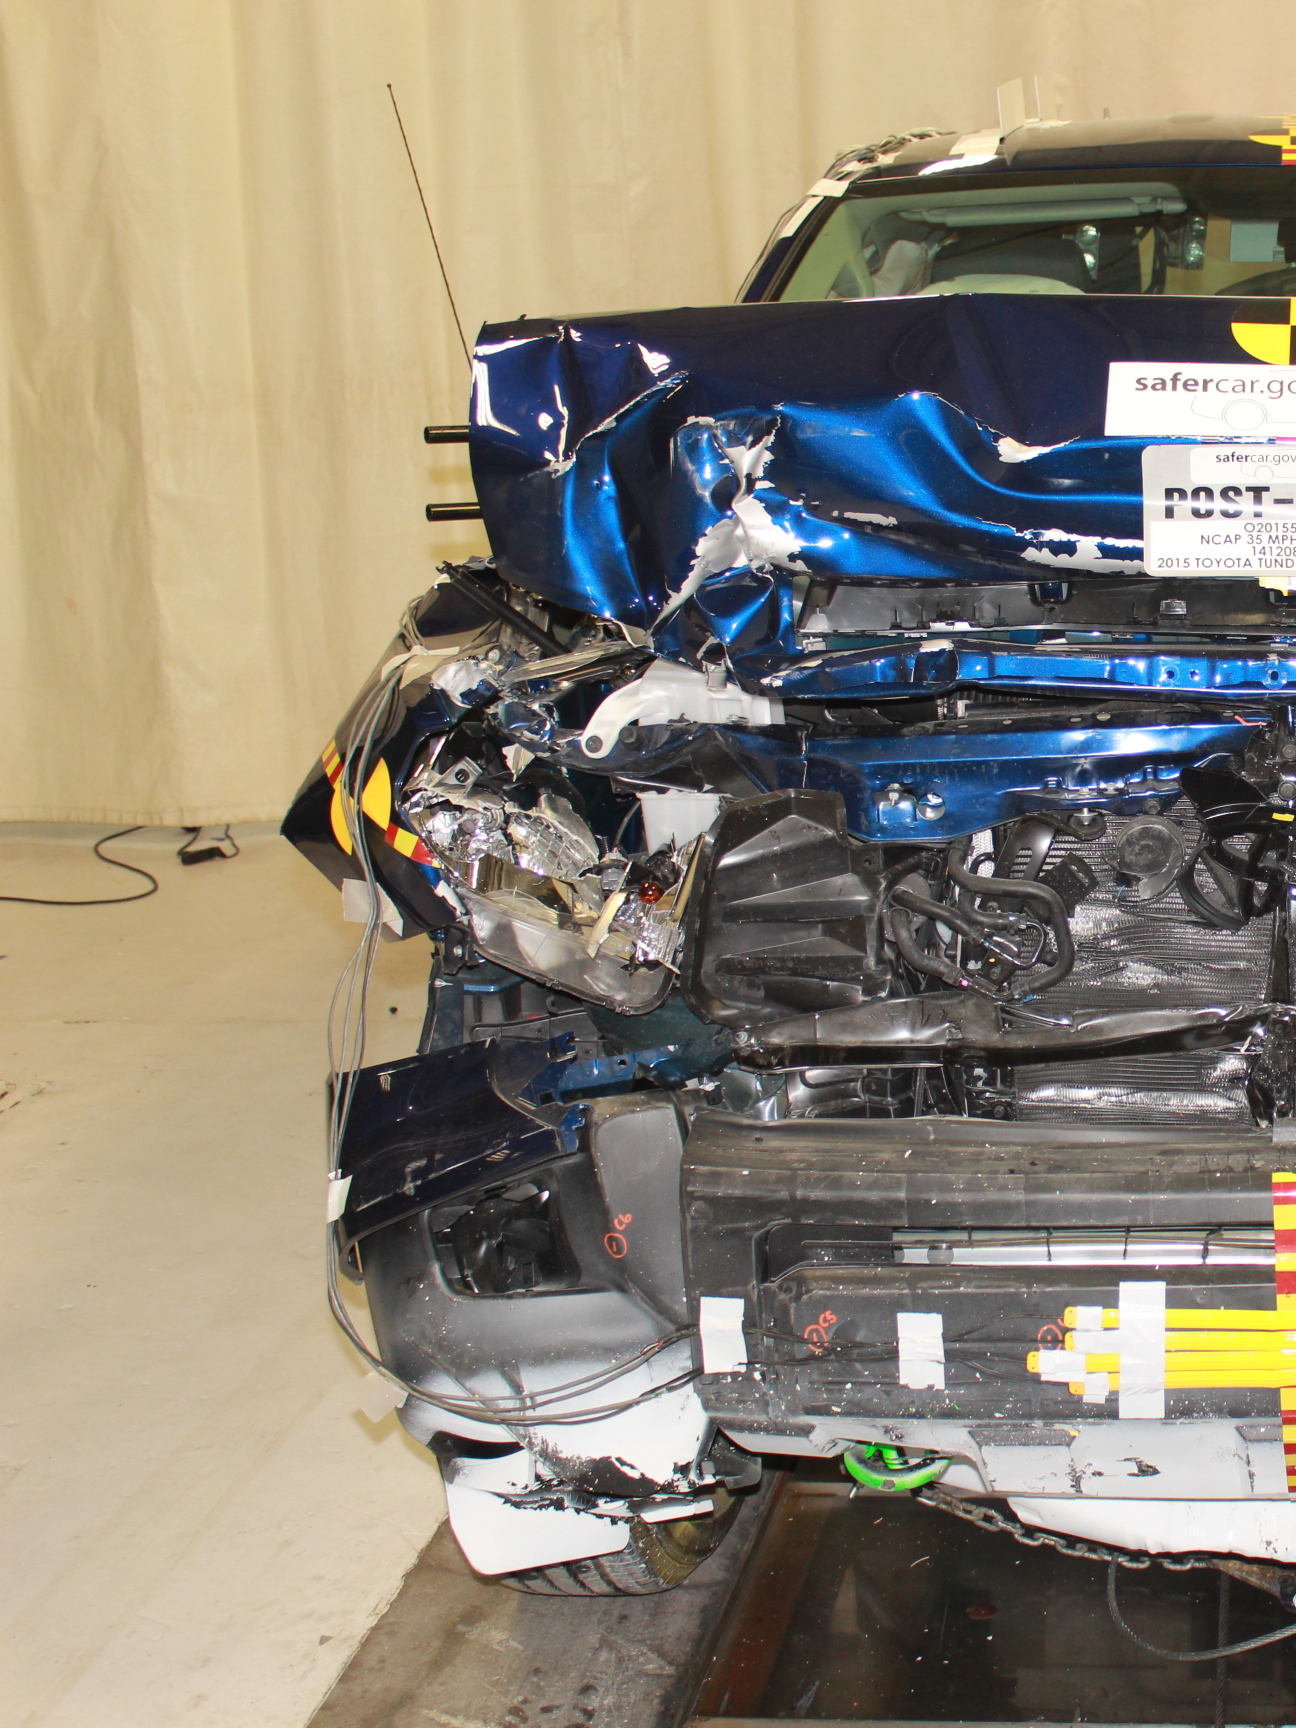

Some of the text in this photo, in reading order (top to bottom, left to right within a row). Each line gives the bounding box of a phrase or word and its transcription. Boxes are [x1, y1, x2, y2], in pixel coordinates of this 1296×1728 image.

[1200, 534, 1242, 545] NCAP
[1247, 534, 1263, 545] 35
[1157, 557, 1190, 569] 2015
[1195, 557, 1253, 569] TOYOTA
